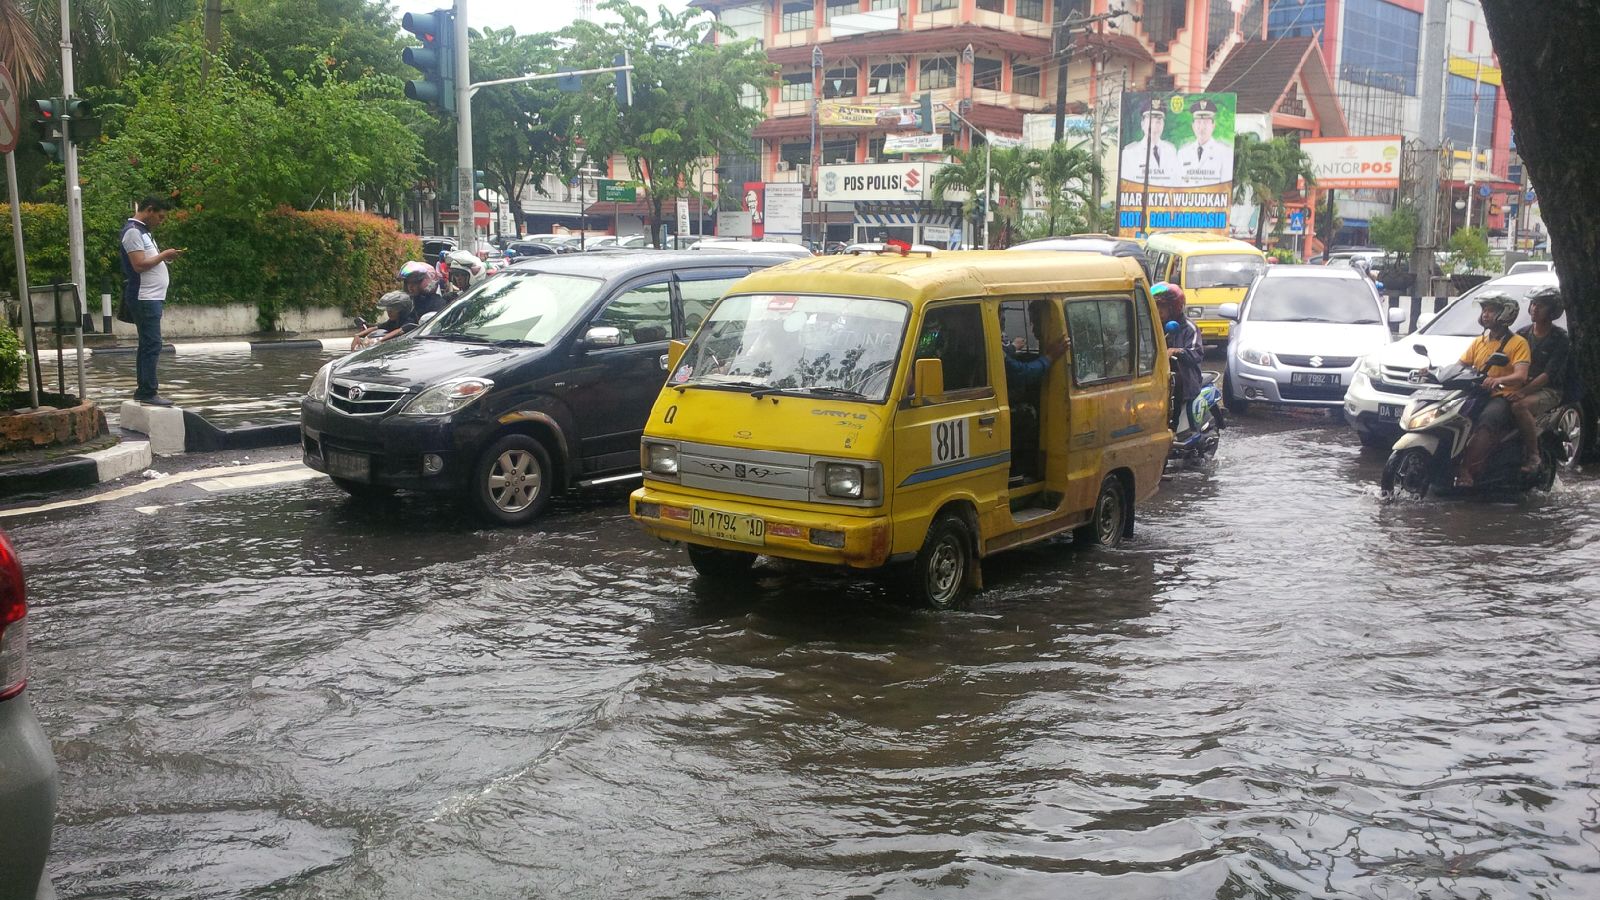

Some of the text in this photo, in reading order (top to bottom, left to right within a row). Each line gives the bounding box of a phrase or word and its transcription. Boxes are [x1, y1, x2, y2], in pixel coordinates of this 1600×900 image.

[844, 175, 902, 190] POS POLISI
[1120, 192, 1228, 207] MAR KITA WUJUDKAN
[1120, 211, 1226, 228] KOT BANJARMASIN
[1380, 406, 1391, 417] DA
[936, 420, 965, 461] 811
[692, 508, 763, 537] DA 1794 AD
